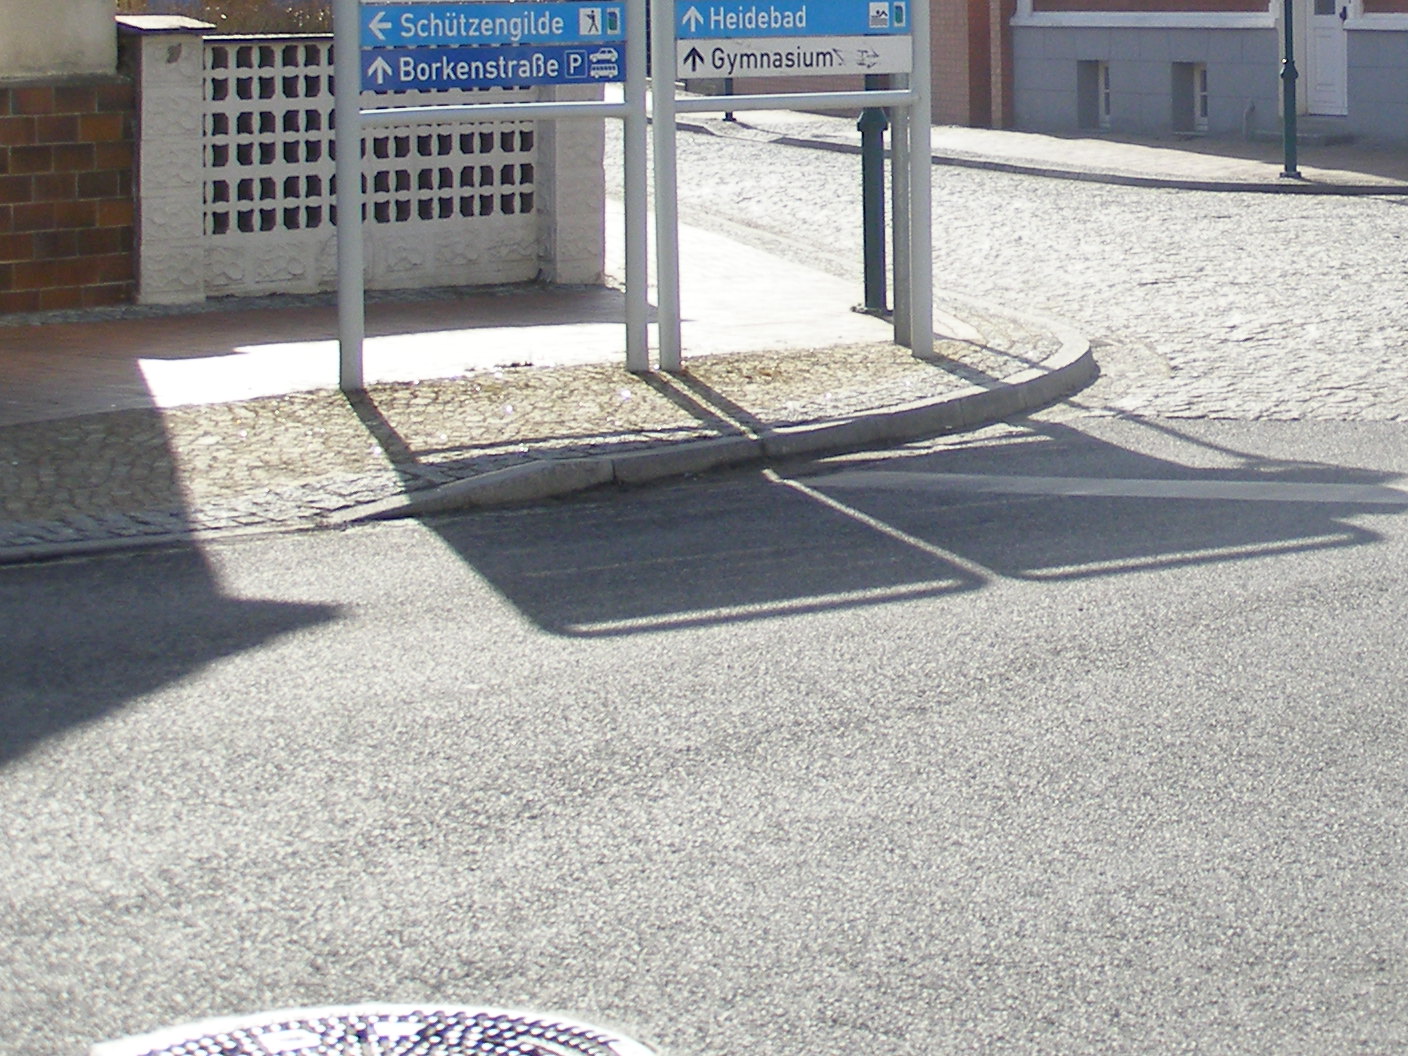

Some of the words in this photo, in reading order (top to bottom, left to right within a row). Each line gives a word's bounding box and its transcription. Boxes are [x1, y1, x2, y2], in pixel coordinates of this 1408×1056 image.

[400, 12, 564, 41] Schützengilde
[710, 6, 806, 30] Heidebad
[400, 53, 558, 80] Borkenstraße
[712, 46, 834, 75] Gymnasium
